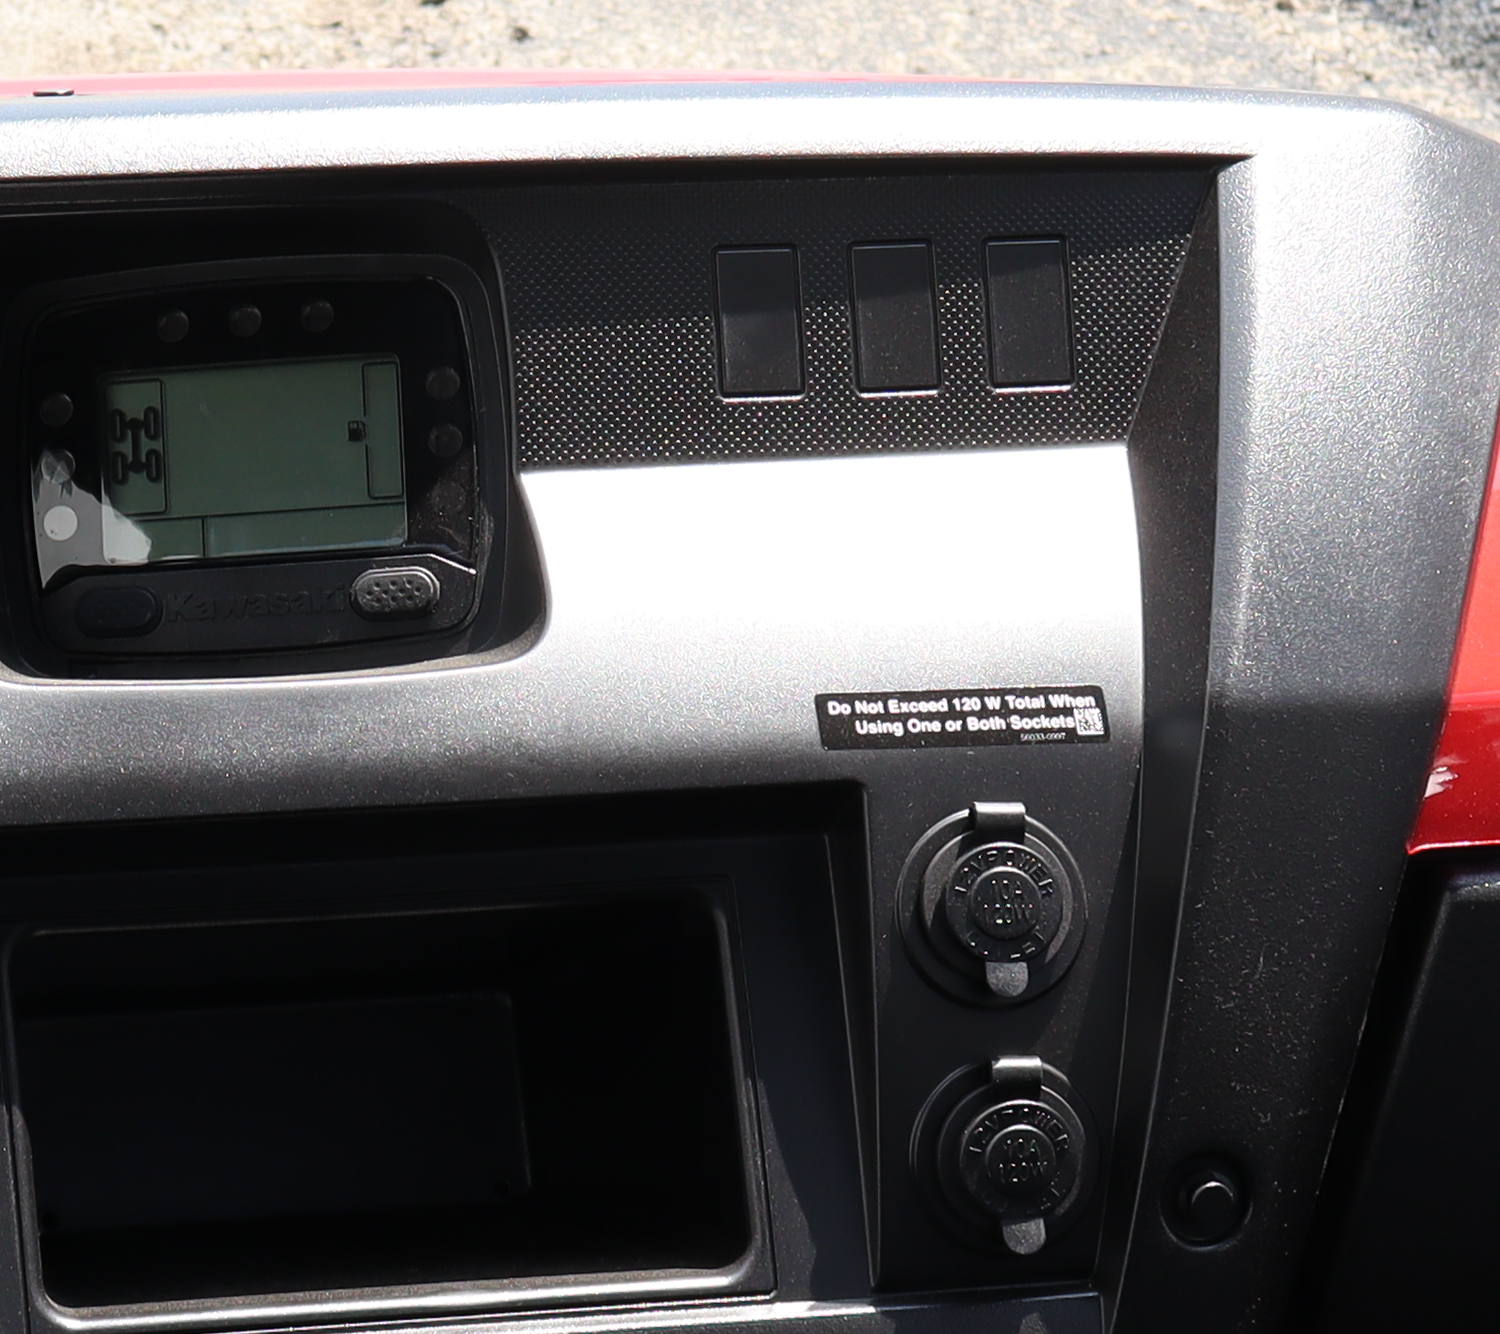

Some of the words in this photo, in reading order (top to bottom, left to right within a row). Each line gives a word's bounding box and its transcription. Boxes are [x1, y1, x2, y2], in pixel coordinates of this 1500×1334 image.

[164, 584, 346, 622] Kawasaki
[827, 701, 851, 715] Do
[854, 699, 884, 715] Not
[887, 697, 948, 713] Exceed
[952, 696, 981, 711] 120
[984, 696, 1002, 710] W
[1004, 694, 1045, 709] Total
[1048, 693, 1096, 708] When
[855, 719, 905, 737] Using
[907, 717, 941, 733] One
[944, 718, 964, 732] or
[966, 715, 1007, 731] Both
[1008, 713, 1075, 730] Sockets
